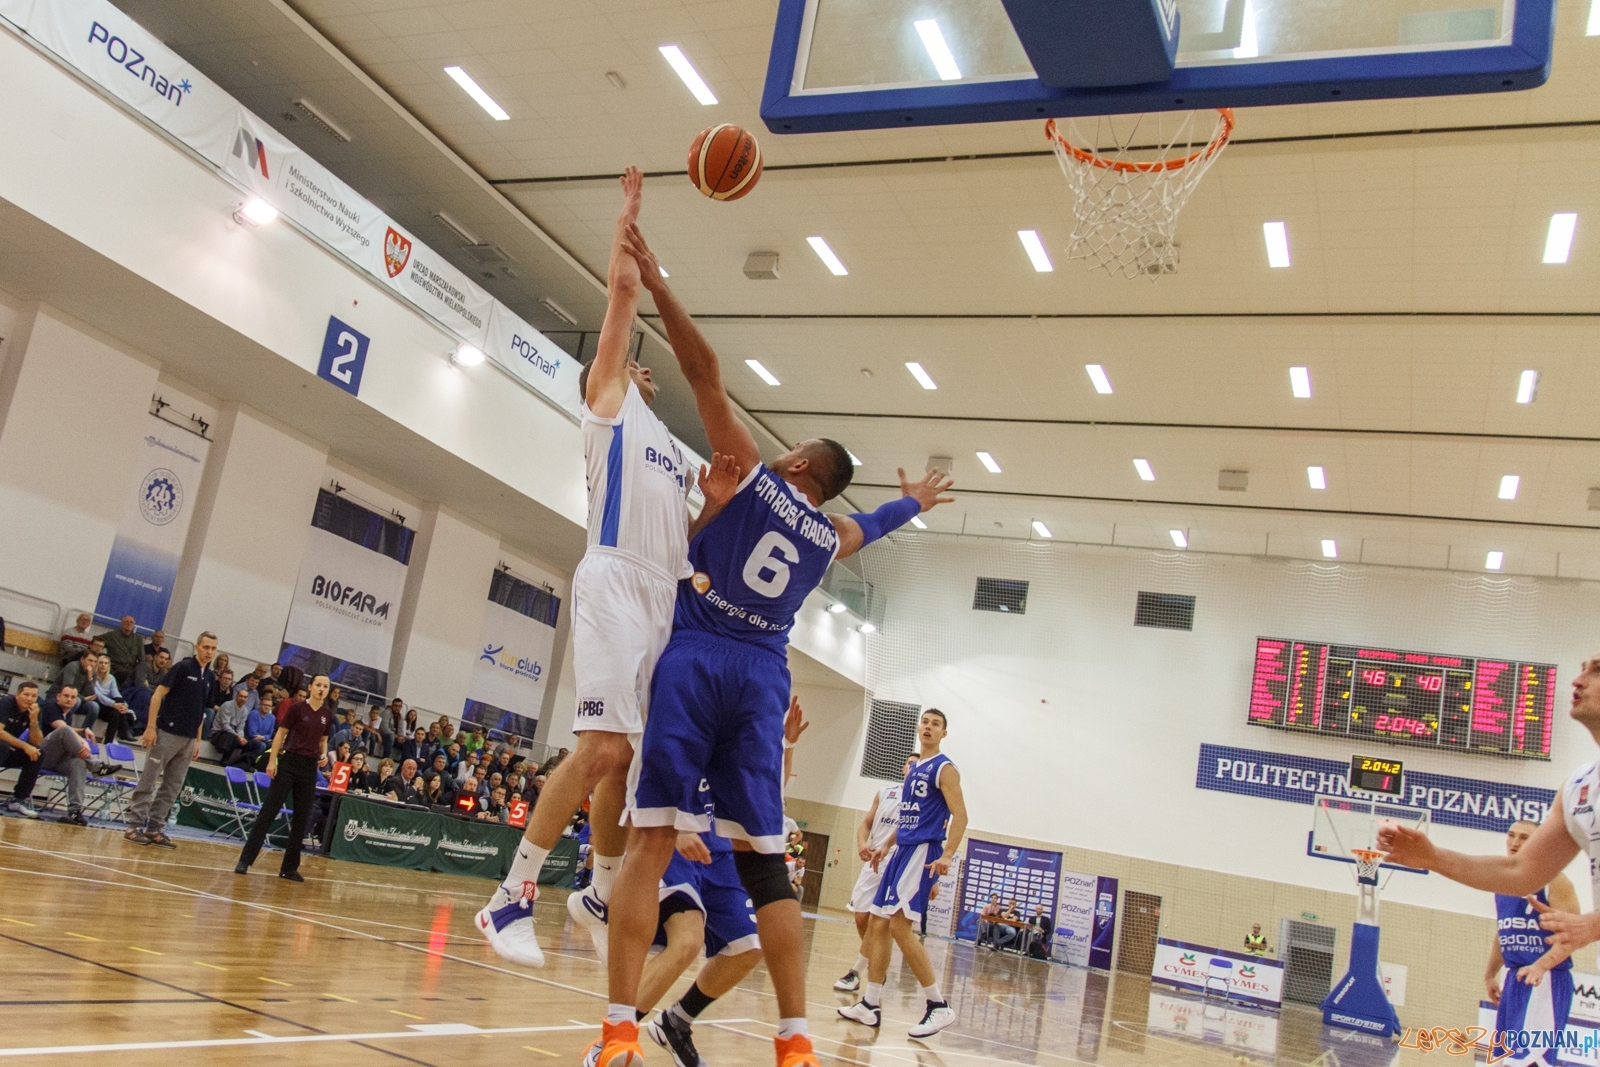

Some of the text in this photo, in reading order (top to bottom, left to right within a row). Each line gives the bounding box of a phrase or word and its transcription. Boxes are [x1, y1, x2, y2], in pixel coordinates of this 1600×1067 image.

[288, 165, 361, 224] Ministerstwo Nauki
[289, 182, 335, 221] Szkolnictwa
[335, 215, 370, 247] Wyższego
[412, 258, 467, 304] URZĄD MARSZAŁKOWSKI
[410, 270, 483, 329] WOJEWÓDZTWA WIELKOPOLSKIEGO
[330, 330, 359, 385] 2
[755, 473, 780, 504] UTH
[770, 492, 803, 531] ROSA
[742, 530, 800, 598] 6
[311, 574, 391, 621] BIOFARM
[705, 589, 768, 630] Energia dla
[1362, 670, 1386, 686] 46
[1394, 679, 1402, 687] 3
[1417, 675, 1443, 692] 40
[1464, 681, 1472, 690] 3
[1341, 691, 1350, 699] 2
[582, 700, 604, 717] PBG
[1351, 712, 1359, 720] 4
[1461, 704, 1470, 712] 4
[1430, 721, 1439, 729] 4
[333, 765, 350, 784] 5
[910, 779, 928, 798] 13
[1382, 776, 1391, 791] 1
[511, 802, 527, 819] 5
[1499, 934, 1543, 946] adom
[1163, 964, 1208, 980] CYMES
[1223, 976, 1269, 992] CYMES
